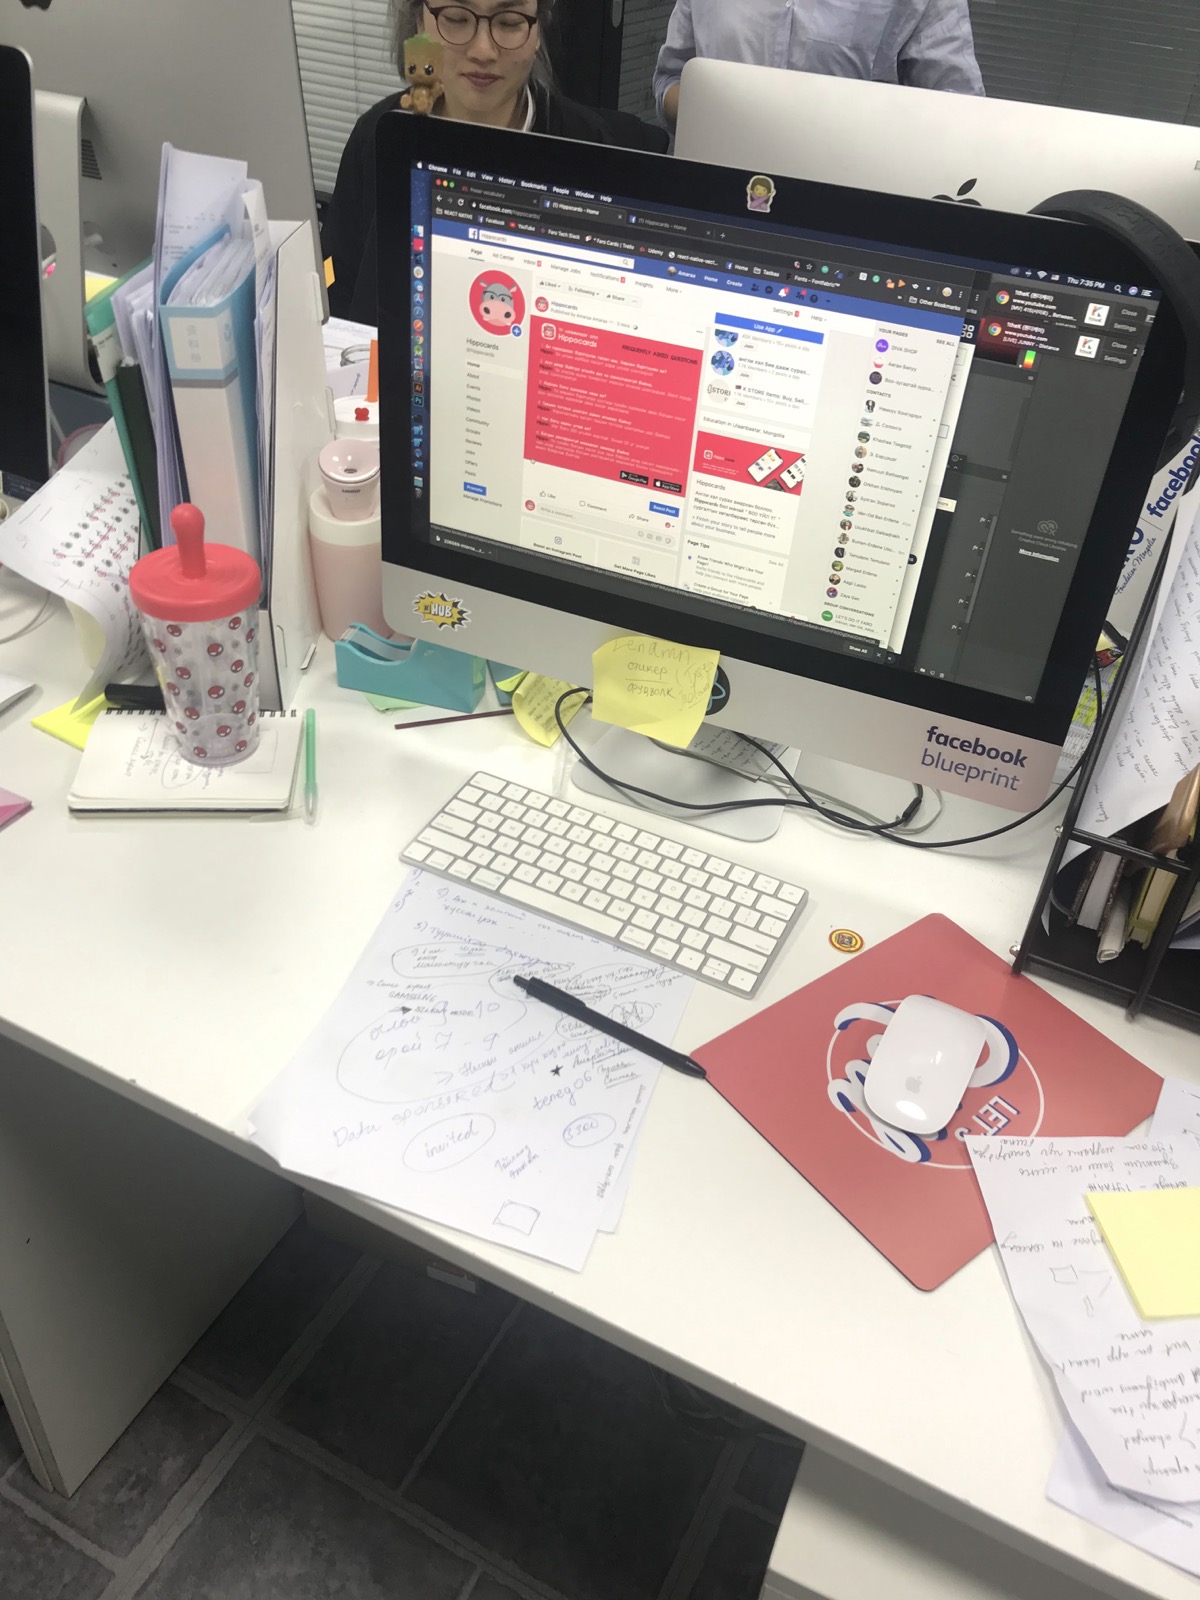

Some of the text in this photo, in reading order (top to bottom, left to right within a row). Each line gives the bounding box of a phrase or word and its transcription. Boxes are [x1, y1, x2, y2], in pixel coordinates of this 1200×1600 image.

[428, 164, 447, 173] Chrome
[481, 173, 493, 181] View
[498, 176, 515, 186] History
[520, 180, 546, 191] Bookmarks
[552, 186, 569, 196] People
[575, 190, 594, 200] Window
[599, 194, 612, 204] Help
[558, 202, 599, 215] Hippocards Home
[644, 218, 686, 231] Hippocards Home
[470, 247, 482, 256] Page
[590, 270, 619, 282] Notifications
[634, 279, 653, 289] Insights
[485, 217, 504, 226] Facebook
[518, 223, 535, 232] YouTube
[647, 247, 663, 257] Udemy
[734, 263, 748, 272] Home
[763, 269, 779, 278] Taobao
[936, 301, 961, 312] Bookmarks
[703, 274, 718, 283] Home
[726, 278, 743, 288] Create
[551, 299, 577, 311] Hippocards
[1012, 297, 1056, 311] www.youtube.com
[772, 306, 793, 317] Settings
[1113, 322, 1136, 332] Settings
[558, 332, 597, 349] Hippocards
[1004, 329, 1047, 342] www.youtube.com
[466, 337, 498, 351] Hippocards
[621, 343, 650, 355] FREQUENTLY
[670, 354, 697, 365] QUESTIONS
[1103, 355, 1126, 365] Settings
[465, 416, 489, 427] Community
[703, 415, 726, 426] Education
[696, 478, 725, 491] Hippocards
[479, 497, 501, 507] Promotions
[430, 602, 454, 618] HUB
[627, 661, 668, 680] стикер
[926, 725, 1028, 768] facebook
[921, 748, 1020, 791] blueprint
